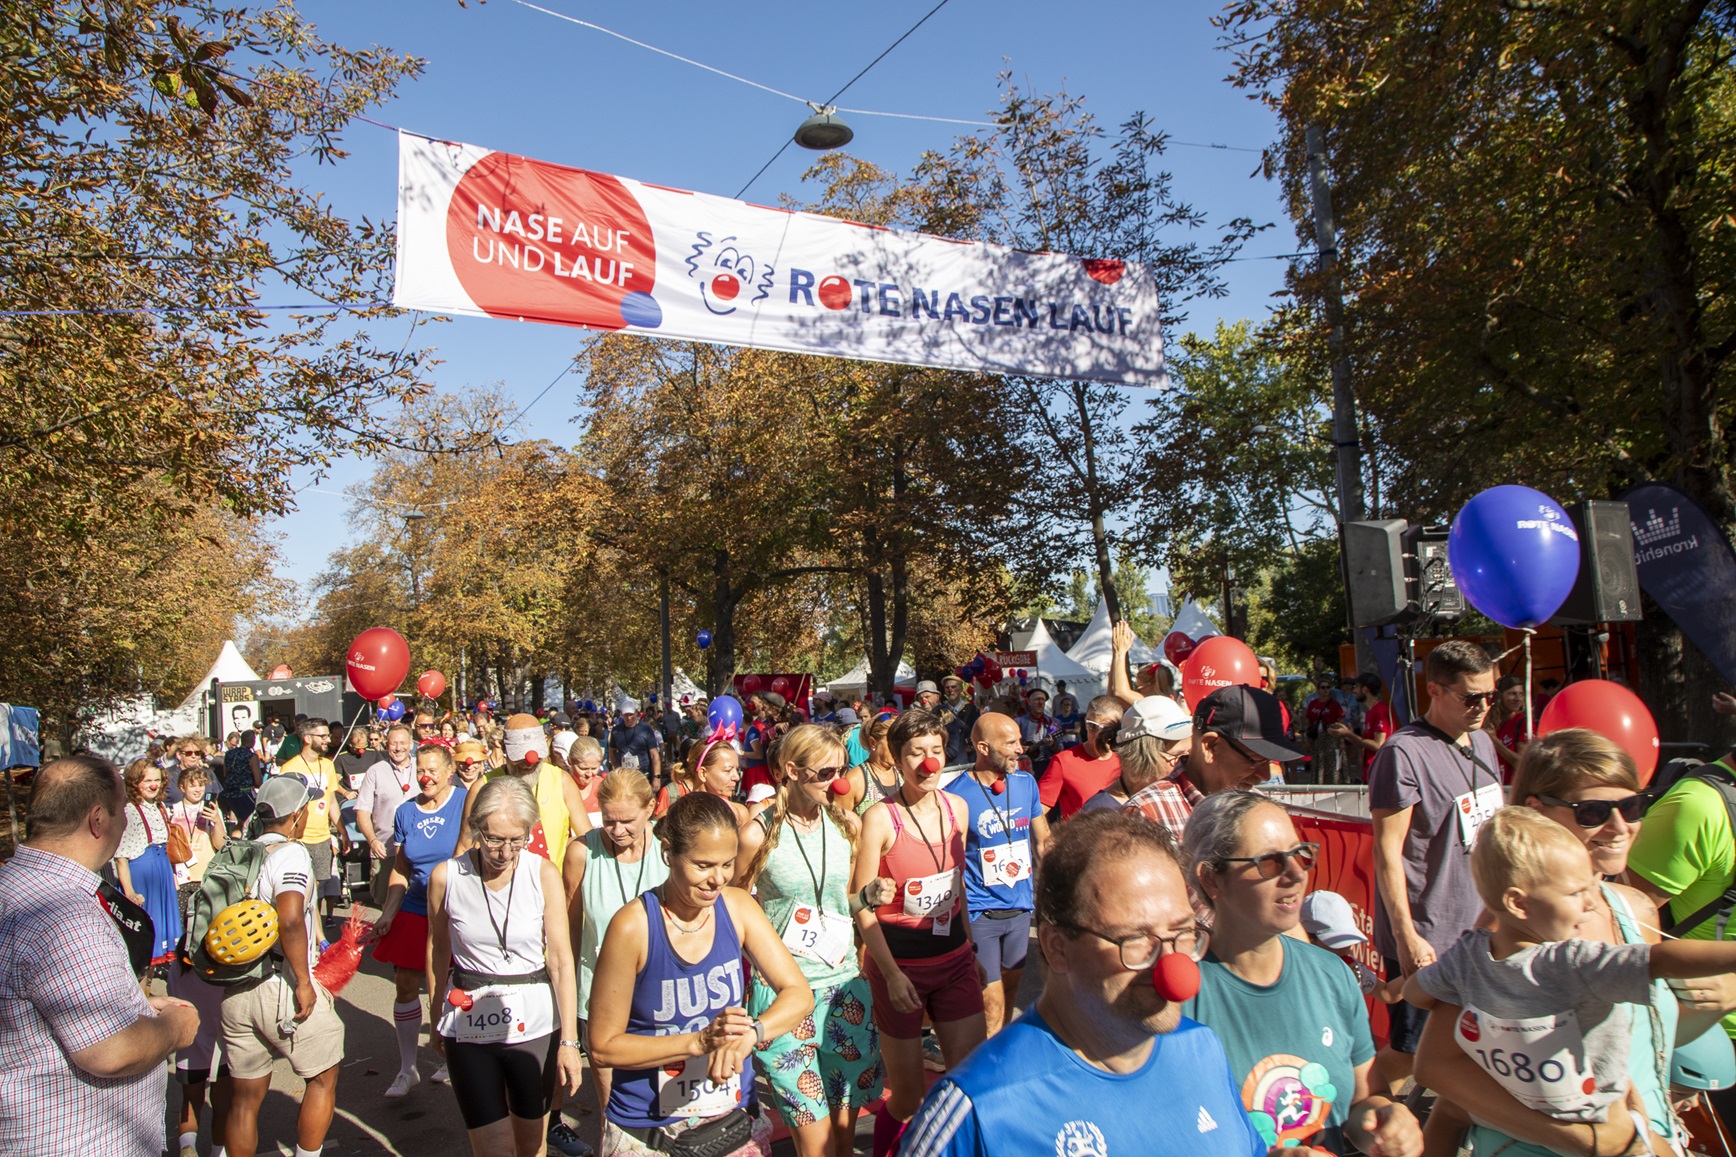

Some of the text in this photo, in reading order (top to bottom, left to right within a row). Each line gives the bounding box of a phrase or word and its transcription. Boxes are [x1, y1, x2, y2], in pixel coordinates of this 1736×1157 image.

[477, 204, 631, 254] NASE AUF
[473, 235, 635, 287] UND LAUF
[788, 267, 1133, 336] ROTE NASEN LAUF
[222, 687, 247, 697] WRAP
[1204, 679, 1233, 687] NASEN
[222, 694, 250, 702] STARS
[916, 889, 953, 911] 1340
[1349, 902, 1374, 936] Sta
[653, 958, 741, 1022] JUST
[466, 1007, 512, 1031] 1408
[1475, 1047, 1565, 1083] 1680
[676, 1078, 730, 1101] 1504
